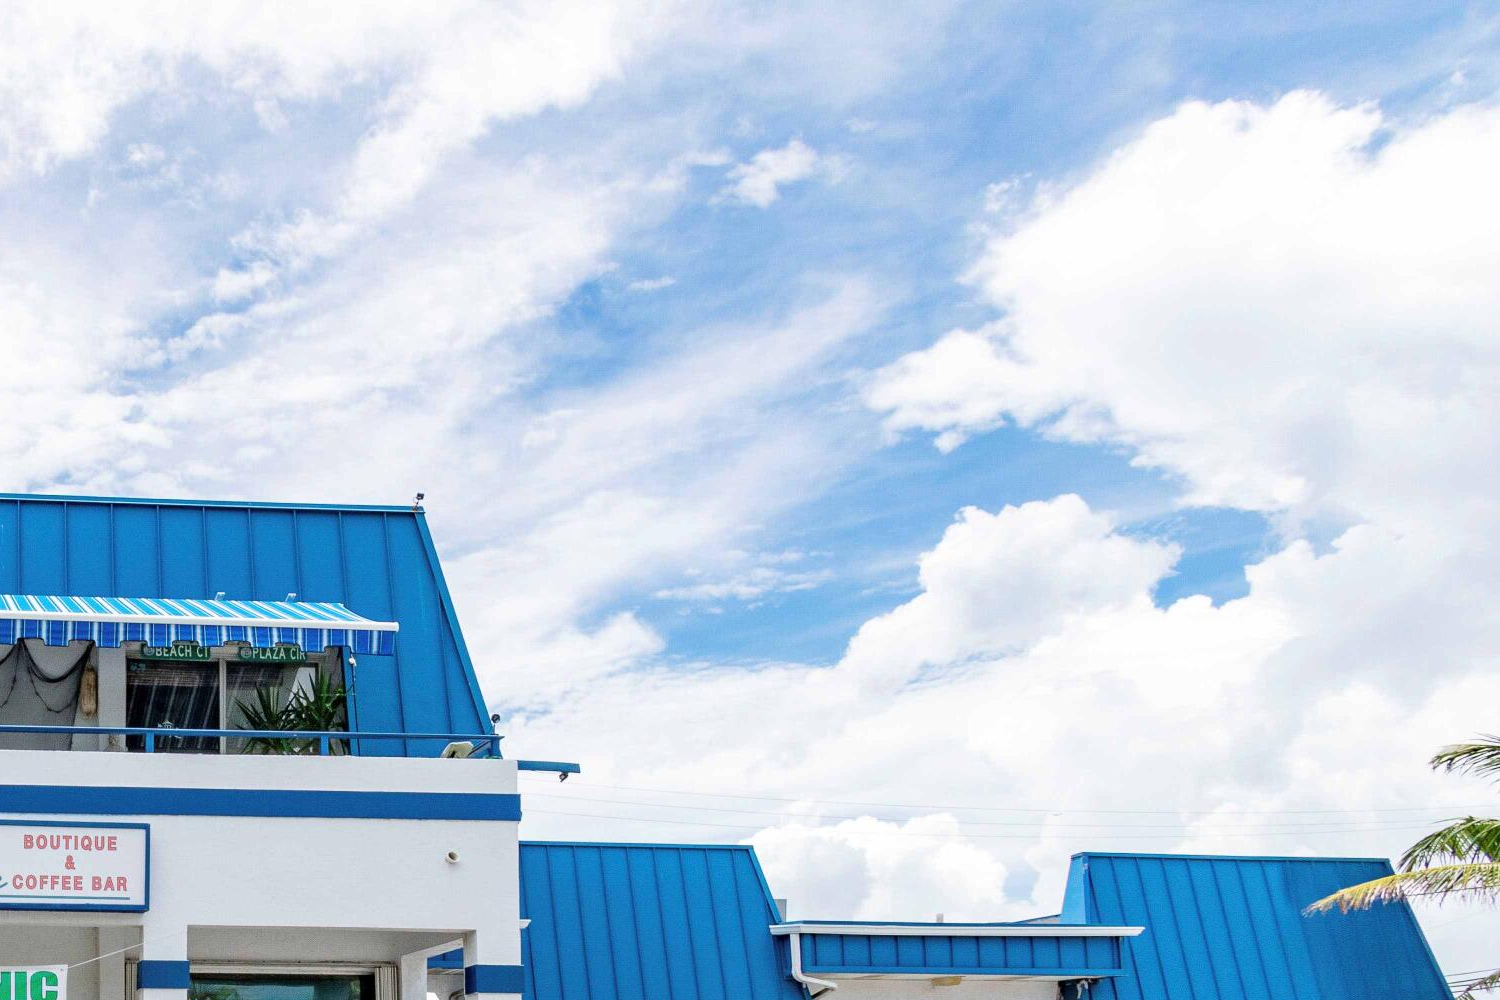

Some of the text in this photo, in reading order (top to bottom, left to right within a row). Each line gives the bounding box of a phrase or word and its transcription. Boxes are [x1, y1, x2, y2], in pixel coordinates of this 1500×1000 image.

[155, 645, 192, 657] BEACH
[252, 647, 306, 660] PLAZA CIR
[23, 834, 117, 851] BOUTIQUE
[64, 854, 76, 870] &
[12, 874, 128, 892] COFFEE BAR
